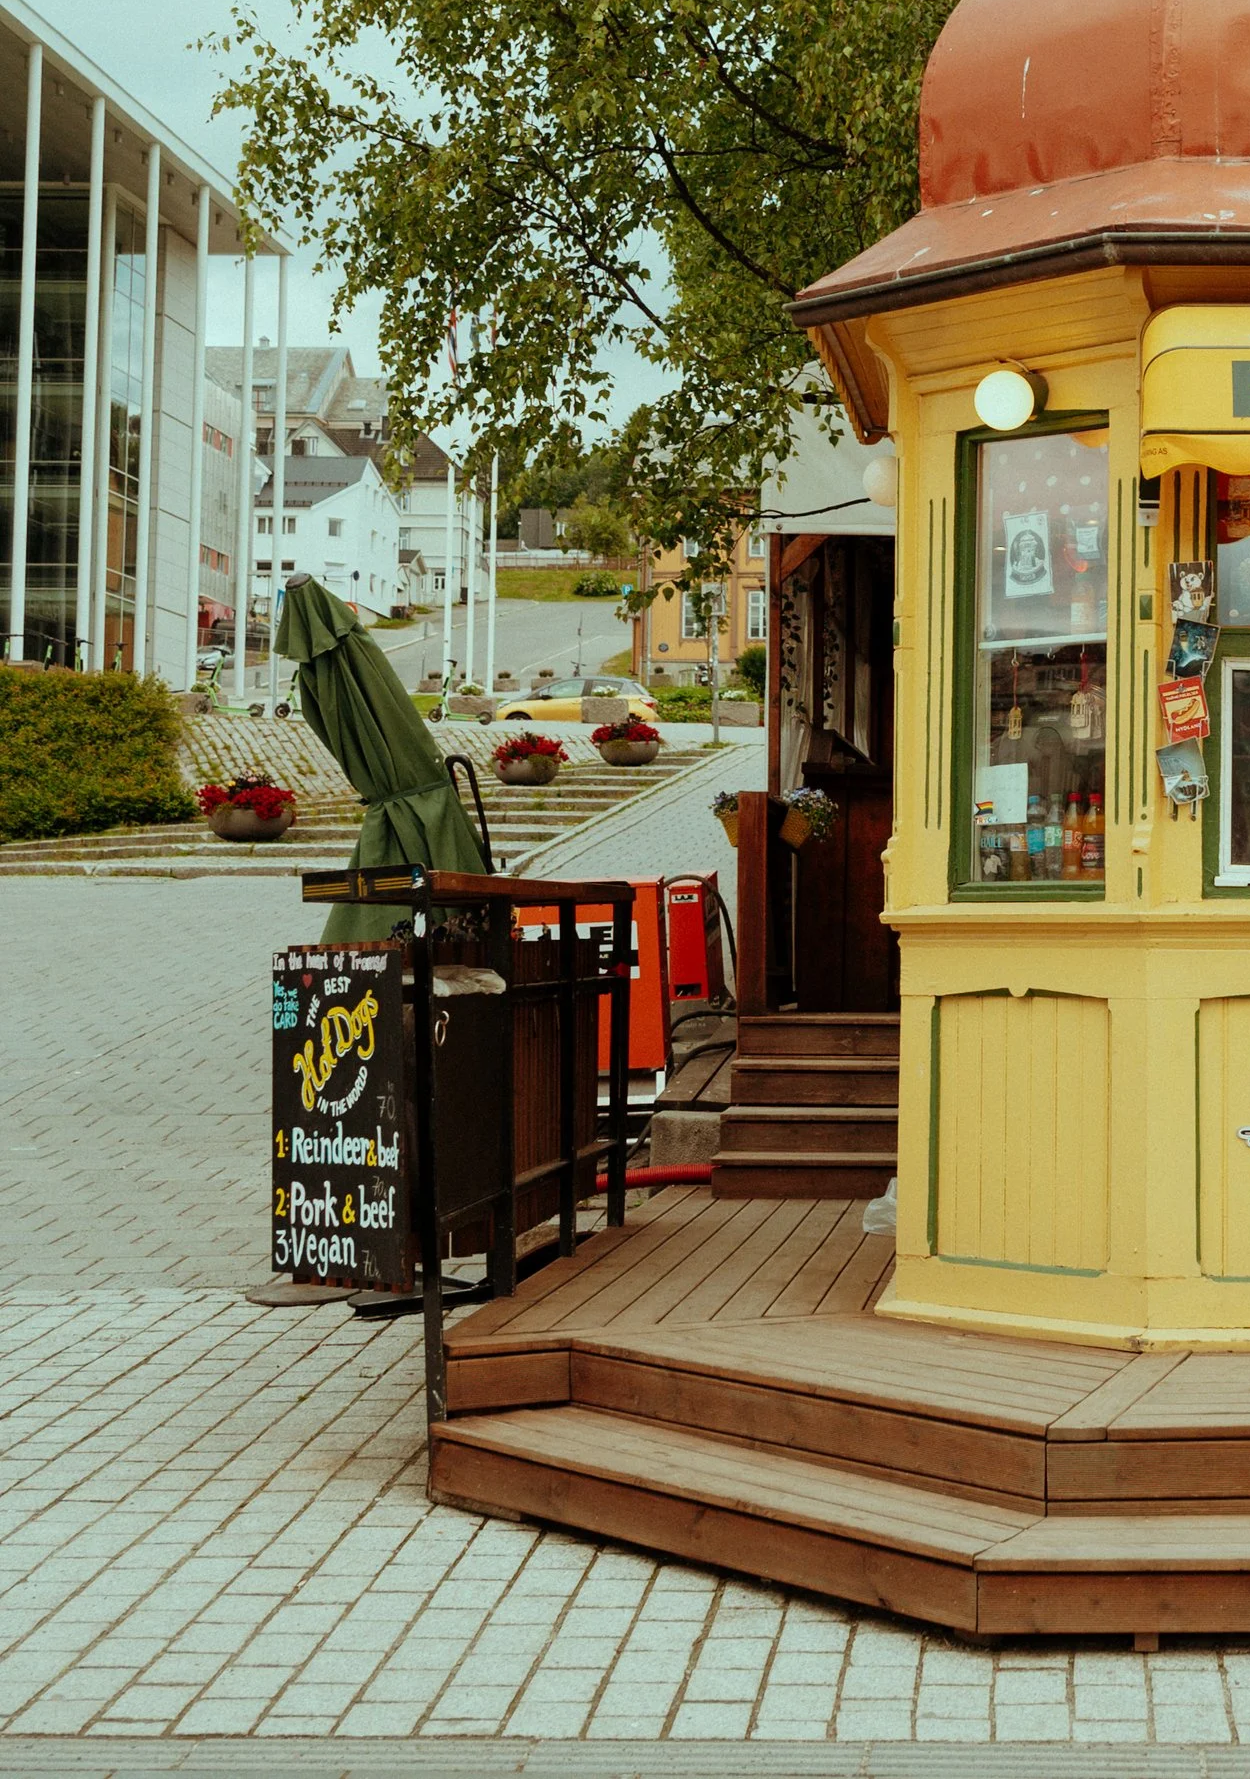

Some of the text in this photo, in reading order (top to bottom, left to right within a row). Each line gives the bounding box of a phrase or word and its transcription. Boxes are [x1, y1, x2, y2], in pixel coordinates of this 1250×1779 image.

[272, 953, 286, 971] In
[288, 951, 303, 971] the
[306, 951, 329, 970] heart
[333, 951, 345, 972] of
[273, 998, 299, 1012] do take
[287, 988, 298, 998] we
[305, 976, 351, 1028] THE BEST
[273, 1012, 298, 1030] CARD
[293, 989, 379, 1112] Hot Dogs
[317, 1065, 369, 1117] IN THE WORLD
[275, 1121, 399, 1170] 1: Reindeer & beef
[275, 1180, 396, 1229] 2: Pork & beef
[275, 1226, 358, 1277] 3: Vegan
